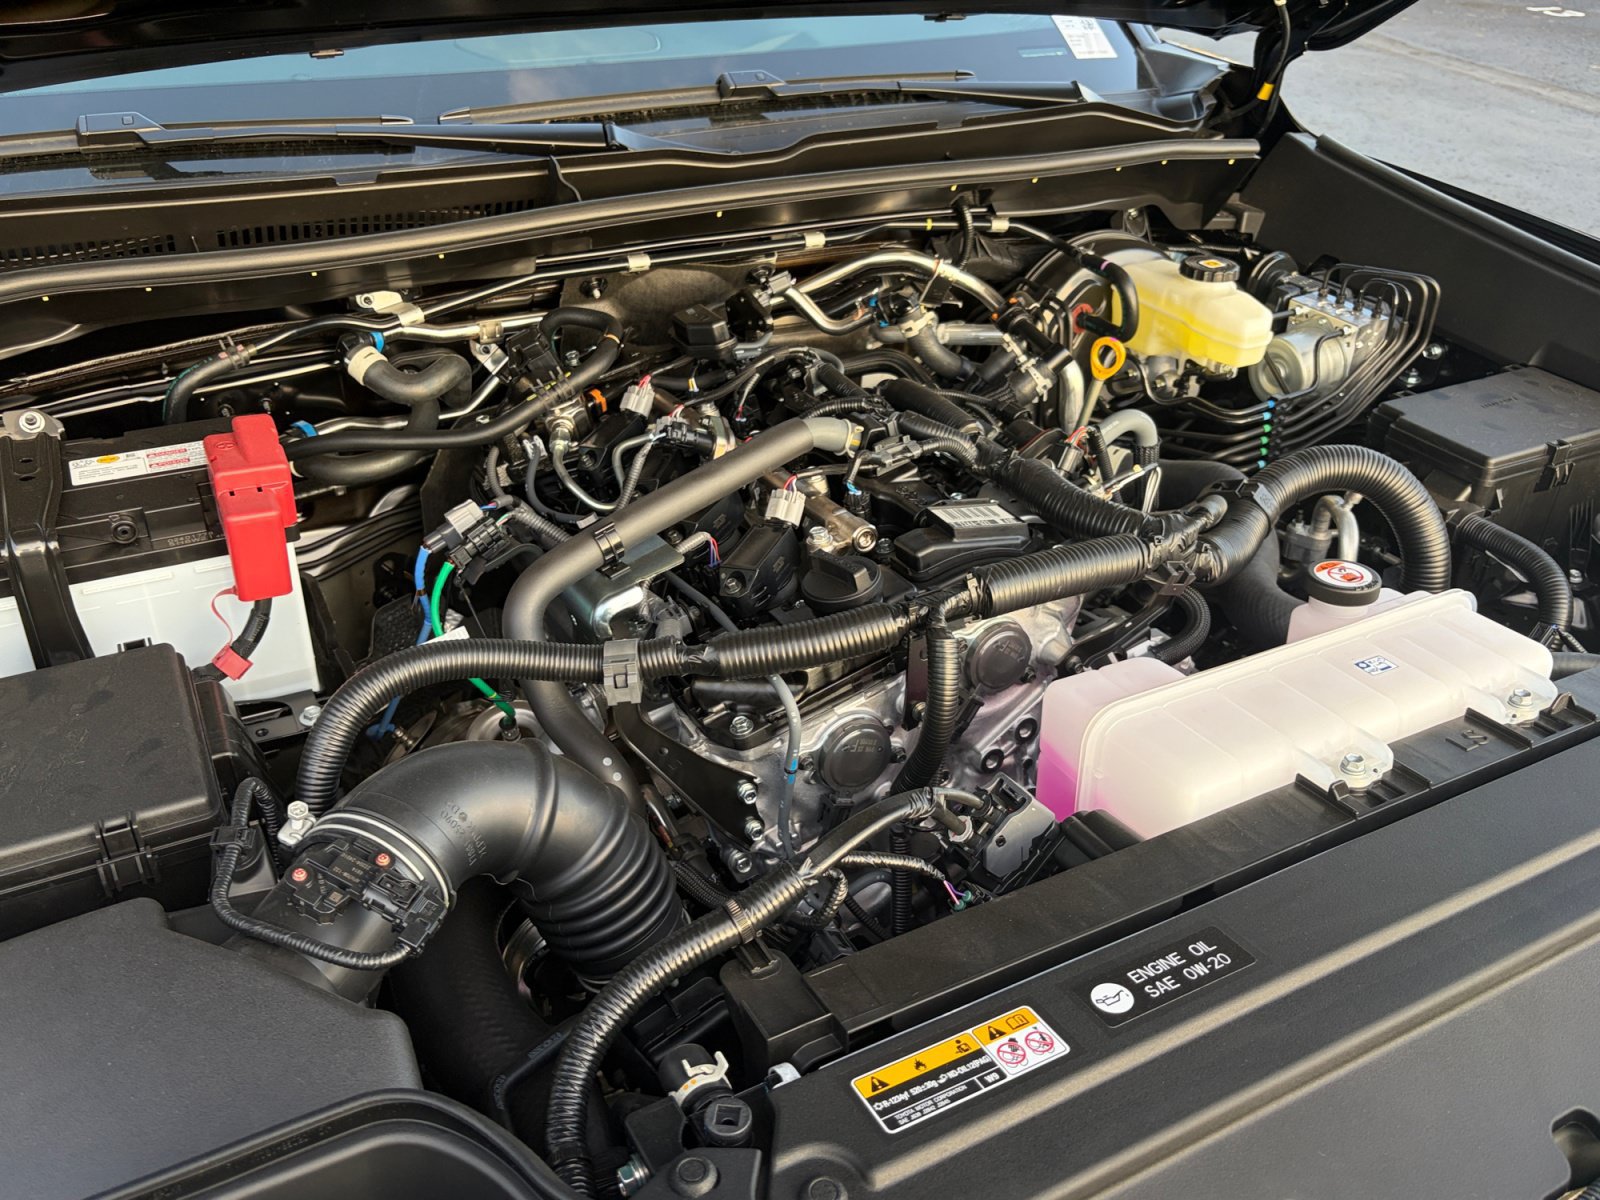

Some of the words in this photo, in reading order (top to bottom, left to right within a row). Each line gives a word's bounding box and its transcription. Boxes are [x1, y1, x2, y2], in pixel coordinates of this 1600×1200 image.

[1126, 951, 1187, 984] ENGINE
[1188, 940, 1218, 956] OIL
[1144, 975, 1181, 998] SAE
[1183, 952, 1232, 980] 0W-20
[983, 1072, 1000, 1083] W9
[894, 1109, 915, 1120] TOYOTA
[914, 1099, 934, 1111] MOTOR
[932, 1084, 968, 1103] CORPORATION
